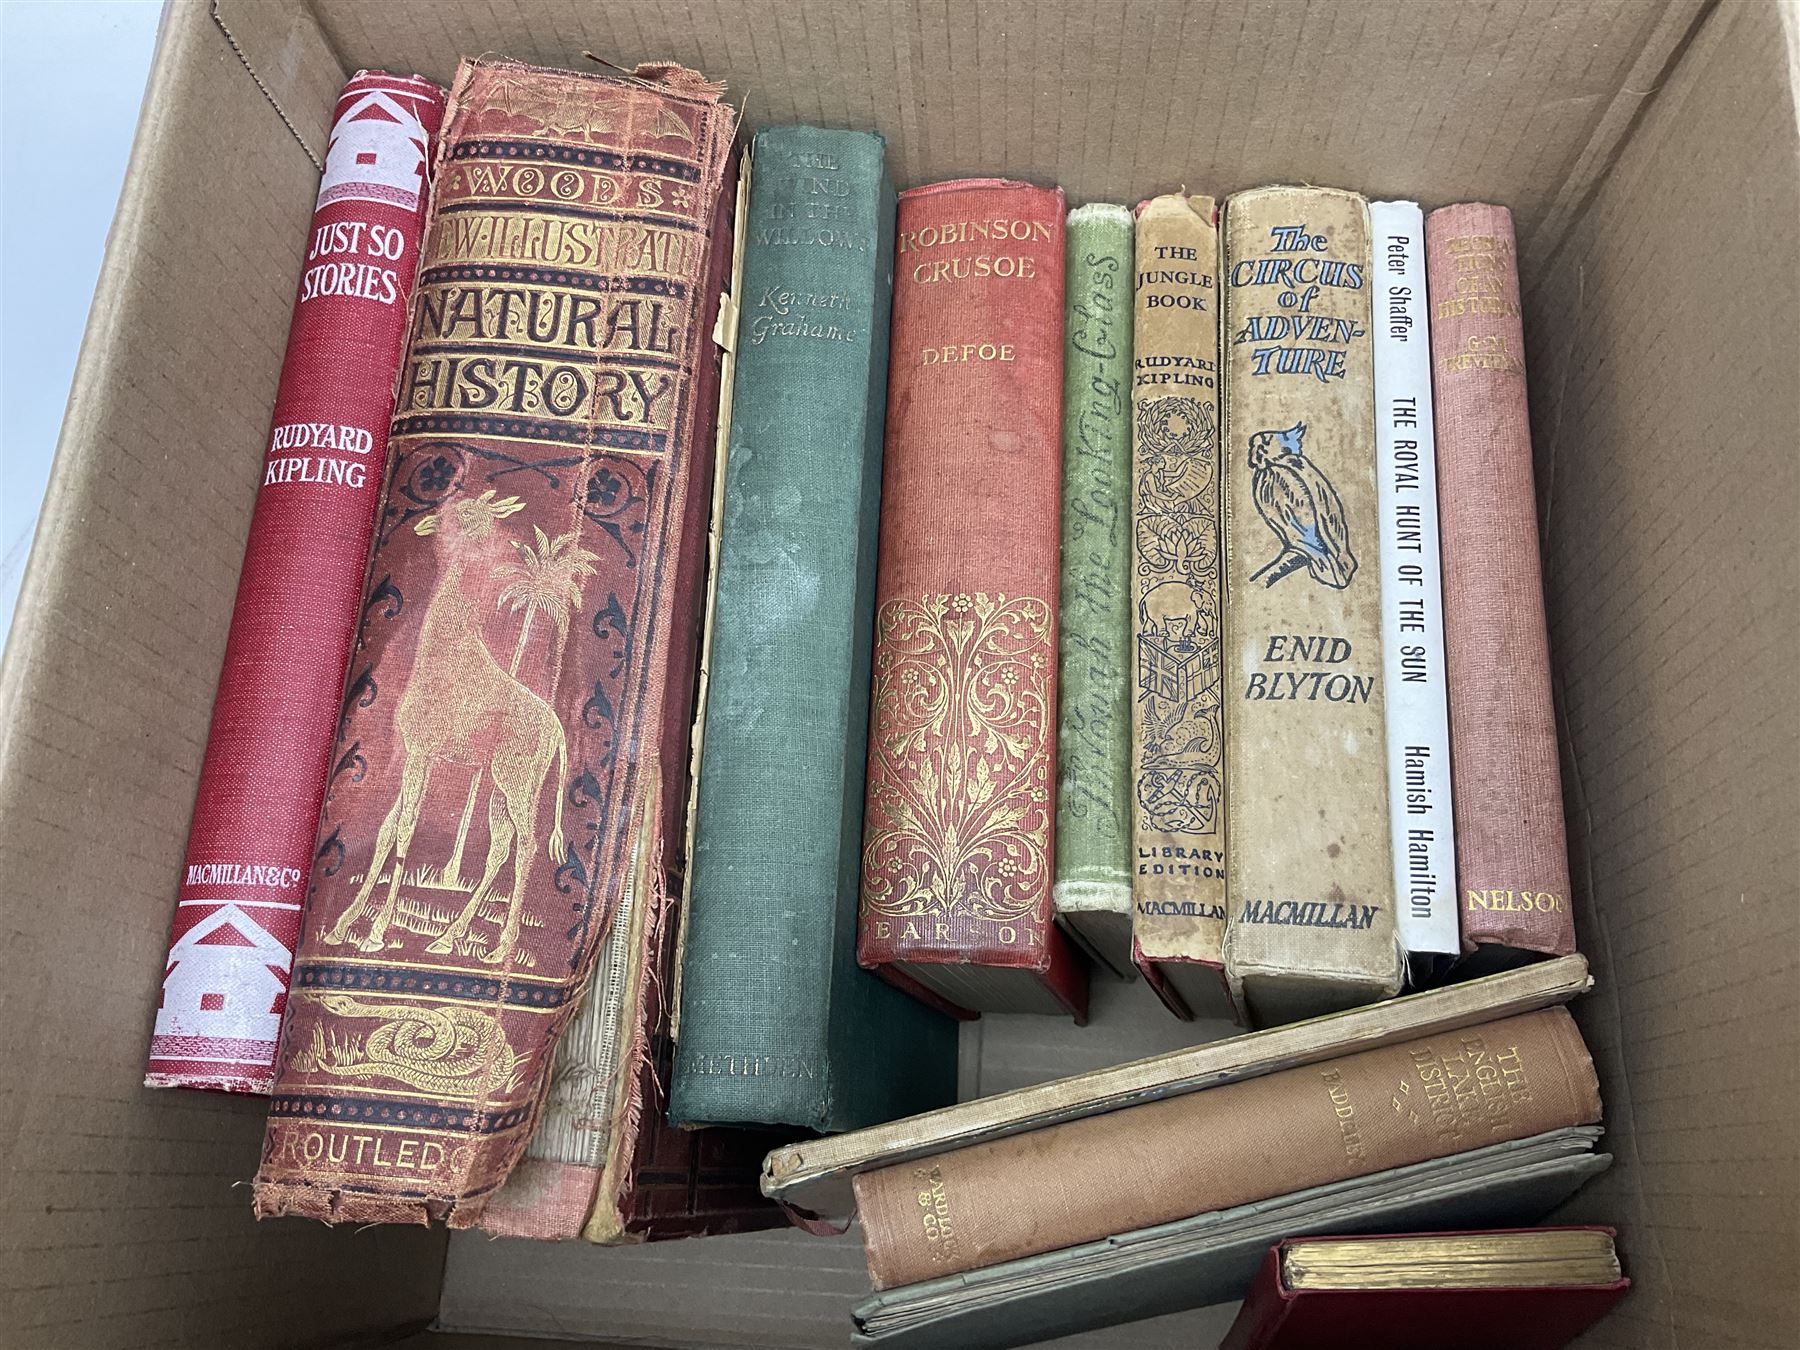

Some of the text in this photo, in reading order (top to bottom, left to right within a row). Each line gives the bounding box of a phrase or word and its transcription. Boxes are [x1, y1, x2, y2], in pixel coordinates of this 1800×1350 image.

[309, 221, 405, 261] JUST SO
[900, 219, 1054, 253] ROBINSON
[1270, 223, 1329, 253] The
[1154, 246, 1198, 261] THE
[300, 262, 398, 304] STORIES
[913, 256, 1037, 284] CRUSOE
[1136, 271, 1213, 291] JUNGLE
[1231, 258, 1364, 289] CIRCUS
[759, 286, 850, 315] Kenneth
[1146, 294, 1207, 312] BOOK
[1277, 284, 1321, 313] of
[1387, 235, 1413, 342] Peter Shaffer
[416, 288, 679, 351] NATURAL
[751, 315, 858, 345] Grahame
[1233, 315, 1366, 345] ADVEN-
[922, 344, 1017, 367] DEFOE
[1251, 345, 1347, 383] TURE
[407, 358, 674, 423] HISTORY
[1136, 373, 1214, 389] KIPLING
[271, 424, 373, 455] RUDYARD
[264, 457, 367, 489] KIPLING
[1392, 397, 1427, 683] THE ROYAL HUNT OF THE SUN
[1263, 634, 1353, 664] ENID
[1245, 671, 1375, 704] BLYTON
[1404, 746, 1437, 919] Hamish Hamilton
[1138, 846, 1224, 863] LIBRARY
[1138, 864, 1225, 880] EDITION
[1137, 901, 1226, 920] MACMILLAN
[1239, 899, 1380, 930] MACMILLAN
[1496, 1046, 1533, 1103] THE
